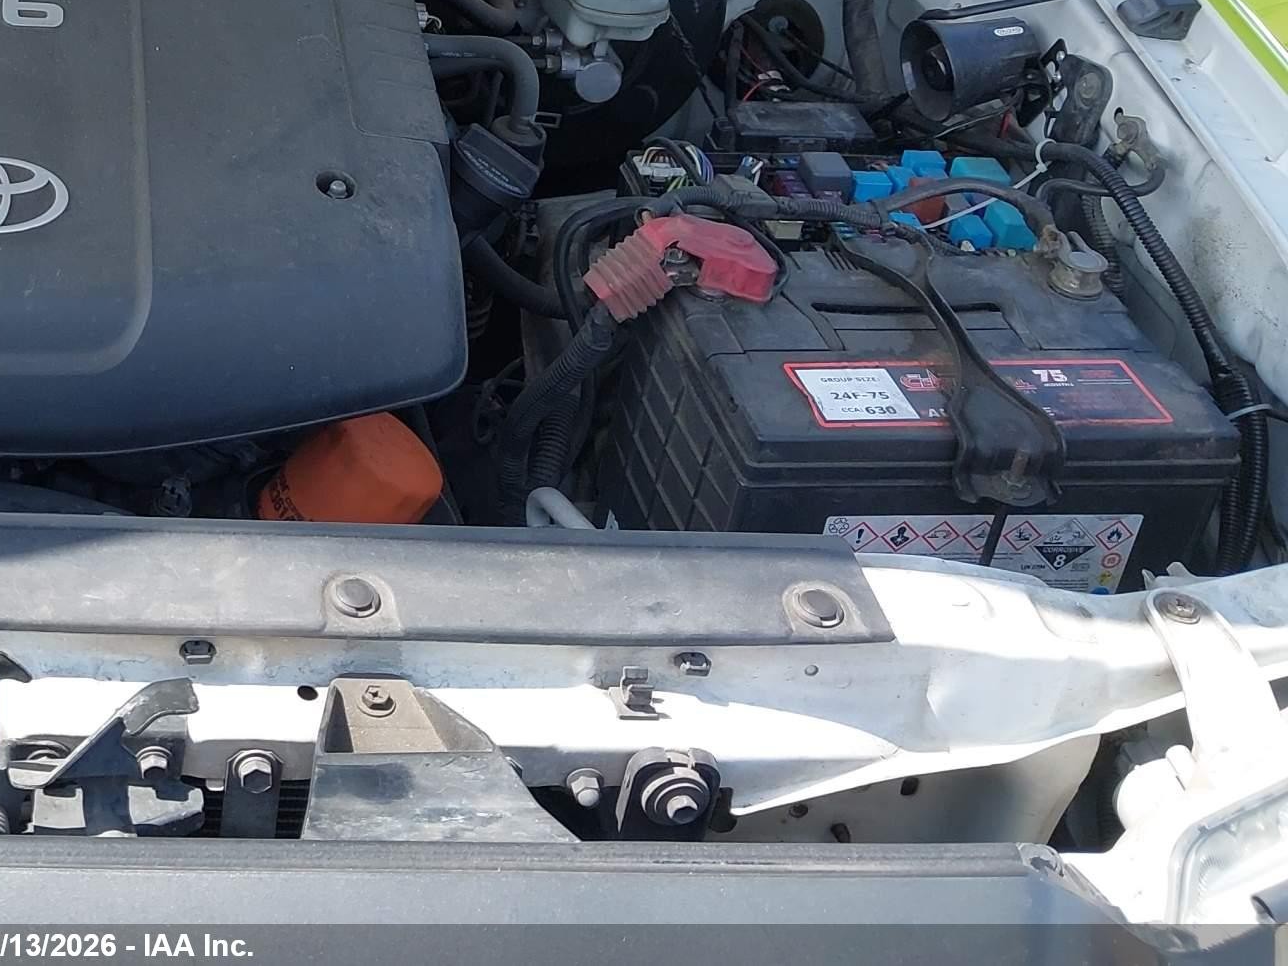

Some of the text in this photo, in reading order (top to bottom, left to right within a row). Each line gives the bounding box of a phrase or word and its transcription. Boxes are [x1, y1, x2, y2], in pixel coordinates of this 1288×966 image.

[1031, 369, 1068, 382] 75
[830, 391, 890, 400] 24F-75
[864, 406, 897, 415] 630
[1053, 554, 1067, 568] 8
